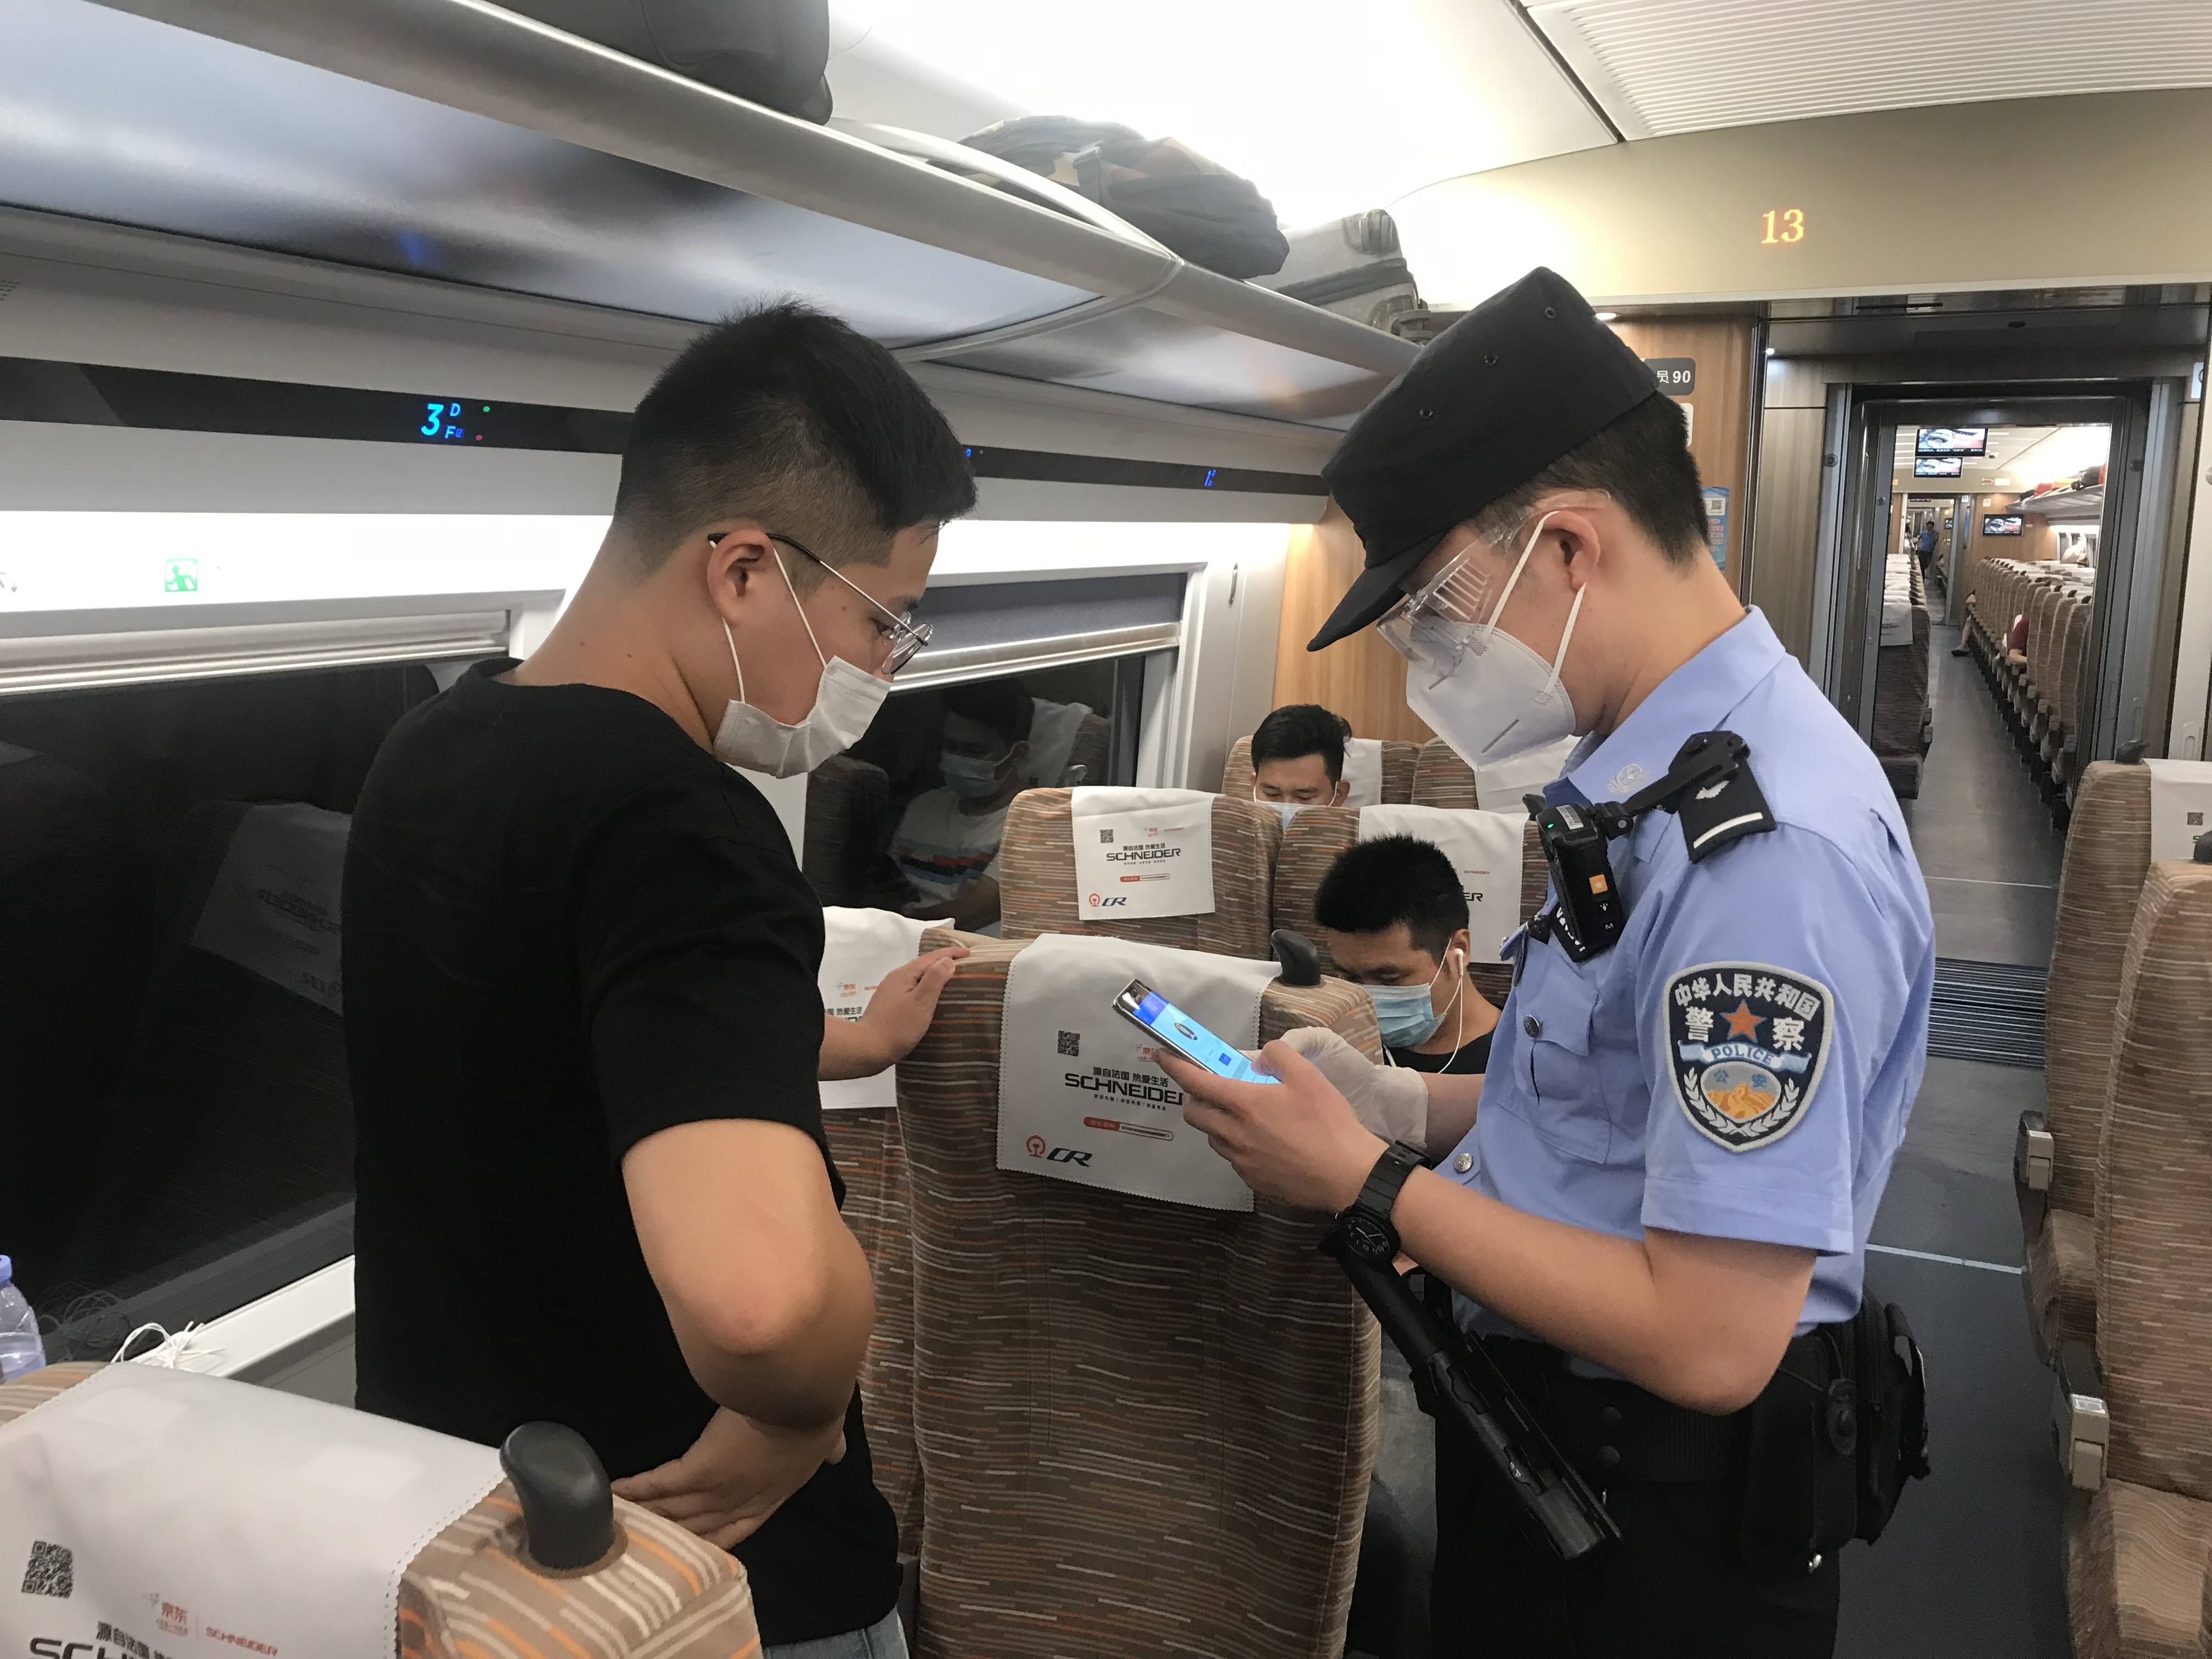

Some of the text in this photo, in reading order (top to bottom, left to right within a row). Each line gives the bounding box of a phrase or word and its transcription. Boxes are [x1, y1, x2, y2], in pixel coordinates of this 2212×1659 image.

[1761, 209, 1804, 244] 13
[1672, 370, 1691, 383] 90
[421, 403, 461, 436] 3 D
[1106, 848, 1181, 861] SCHNEIDER
[1101, 896, 1127, 907] CR
[1674, 973, 1821, 1022] 中华人民共和国
[1685, 1006, 1805, 1051] 警 察
[1711, 1042, 1775, 1065] POLICE
[1093, 1066, 1169, 1087] 源自法国 热爱生活
[1047, 1147, 1093, 1167] CR
